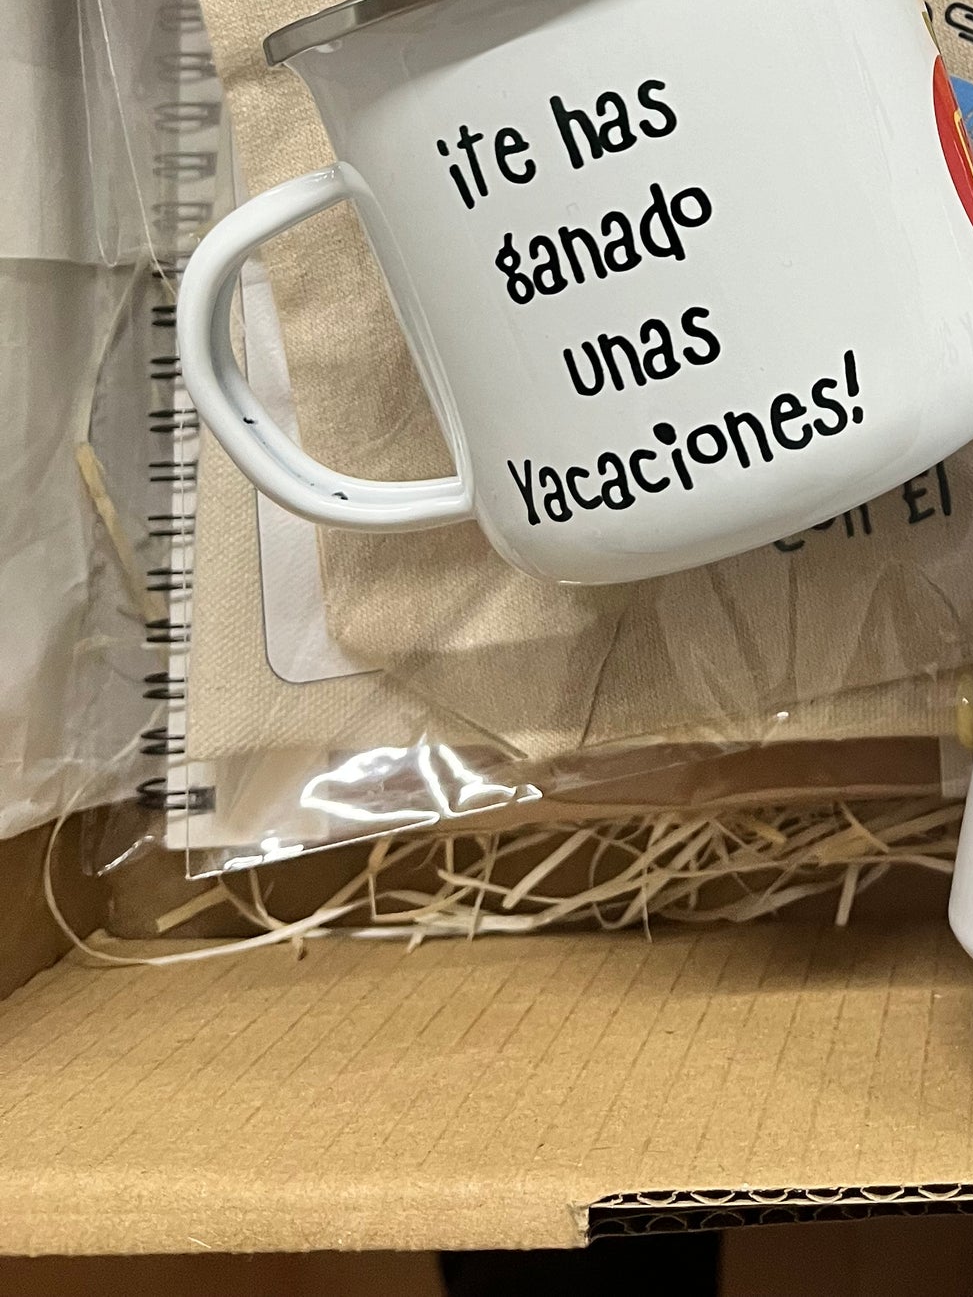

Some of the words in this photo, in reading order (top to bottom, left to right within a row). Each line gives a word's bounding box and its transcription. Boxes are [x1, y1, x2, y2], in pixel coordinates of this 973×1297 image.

[436, 124, 536, 210] ¡te
[549, 79, 678, 170] has
[494, 182, 713, 305] ganado
[563, 306, 721, 397] unas
